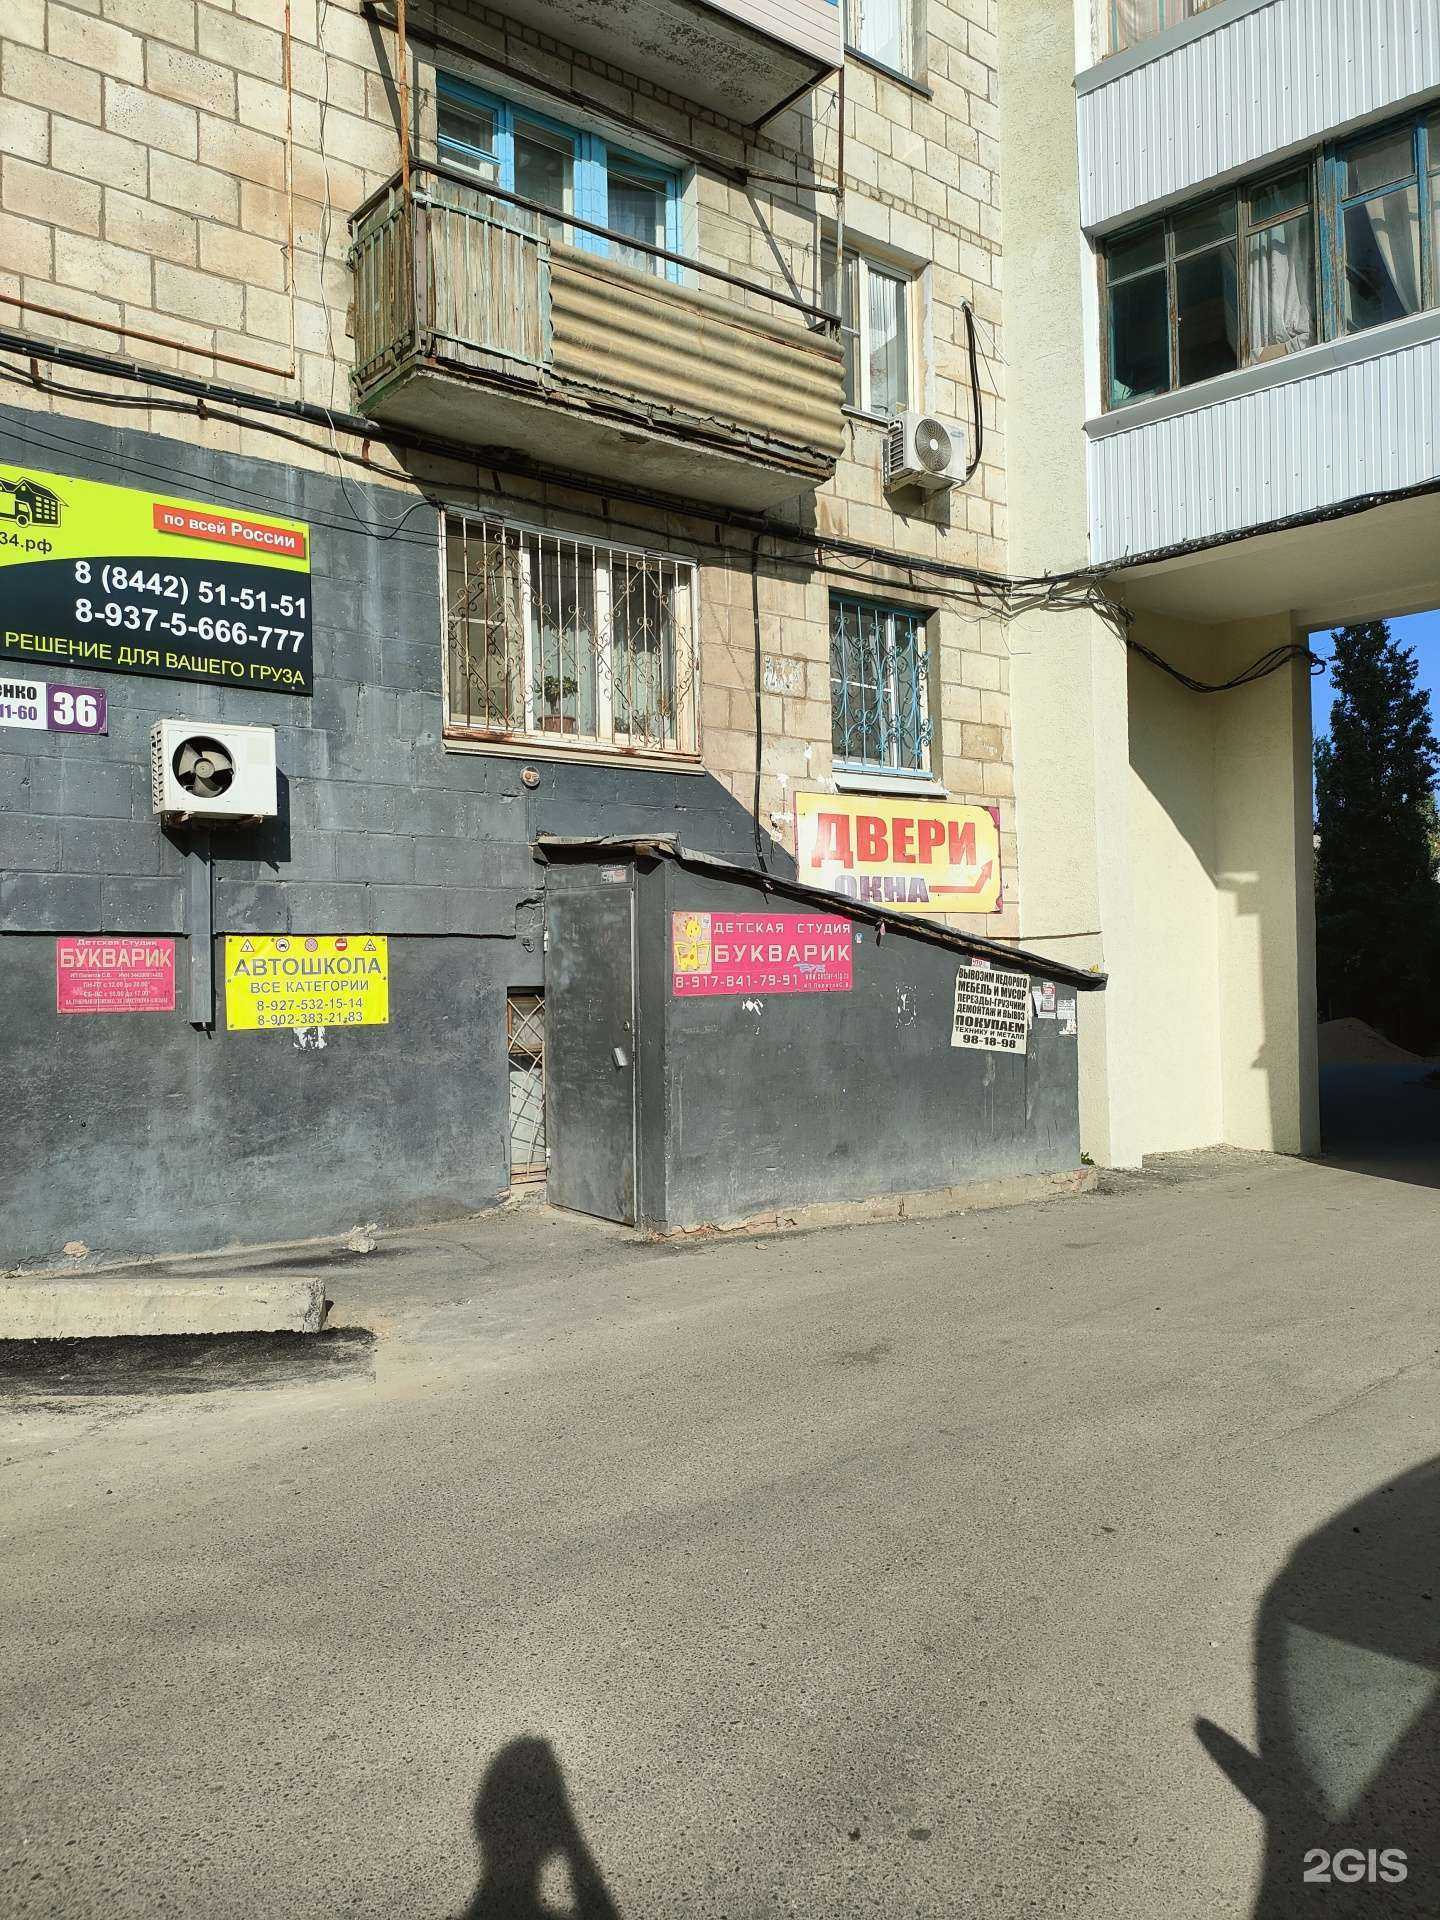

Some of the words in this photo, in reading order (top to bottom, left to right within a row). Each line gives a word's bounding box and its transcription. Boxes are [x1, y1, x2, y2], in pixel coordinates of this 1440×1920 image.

[164, 514, 184, 527] по
[189, 520, 226, 535] всей
[231, 522, 295, 549] России
[75, 560, 91, 584] 8
[102, 564, 188, 605] (8442)
[198, 581, 305, 619] 51-51-51
[75, 598, 305, 653] 8-937-5-666-777
[5, 631, 112, 660] РЕШЕНИЕ
[117, 647, 160, 666] ДЛЯ
[166, 653, 245, 677] ВАШЕГО
[250, 664, 305, 685] ГРУЗА
[53, 691, 97, 727] 36
[811, 812, 977, 869] ДВЕРИ
[834, 874, 930, 903] ОКНА
[713, 922, 784, 934] ДЕТСКАЯ
[797, 923, 850, 935] СТУДИЯ
[60, 948, 171, 968] БУКВАРИК
[714, 944, 850, 963] БУКВАРИК
[234, 957, 381, 976] АВТОШКОЛА
[251, 981, 281, 994] ВСЕ
[286, 979, 369, 993] КАТЕГОРИИ
[675, 974, 798, 988] 8-917-841-79-91
[958, 968, 994, 983] ВЫВОЗИМ
[995, 973, 1027, 988] НЕДОРОГО
[958, 981, 991, 995] МЕБЕЛЬ
[993, 986, 999, 996] И
[1001, 987, 1026, 1000] МУСОР
[257, 998, 363, 1011] 8-927-532-15-14
[957, 1003, 995, 1016] ДЕМОНТАЖ
[997, 1009, 1001, 1017] И
[1003, 1010, 1025, 1020] ВЫВОЗ
[954, 1025, 988, 1035] ТЕХНИКУ
[996, 1031, 1025, 1040] МЕТАЛЛ
[955, 1015, 1025, 1033] ПОКУПАЕМ
[963, 1034, 1016, 1048] 98-18-98
